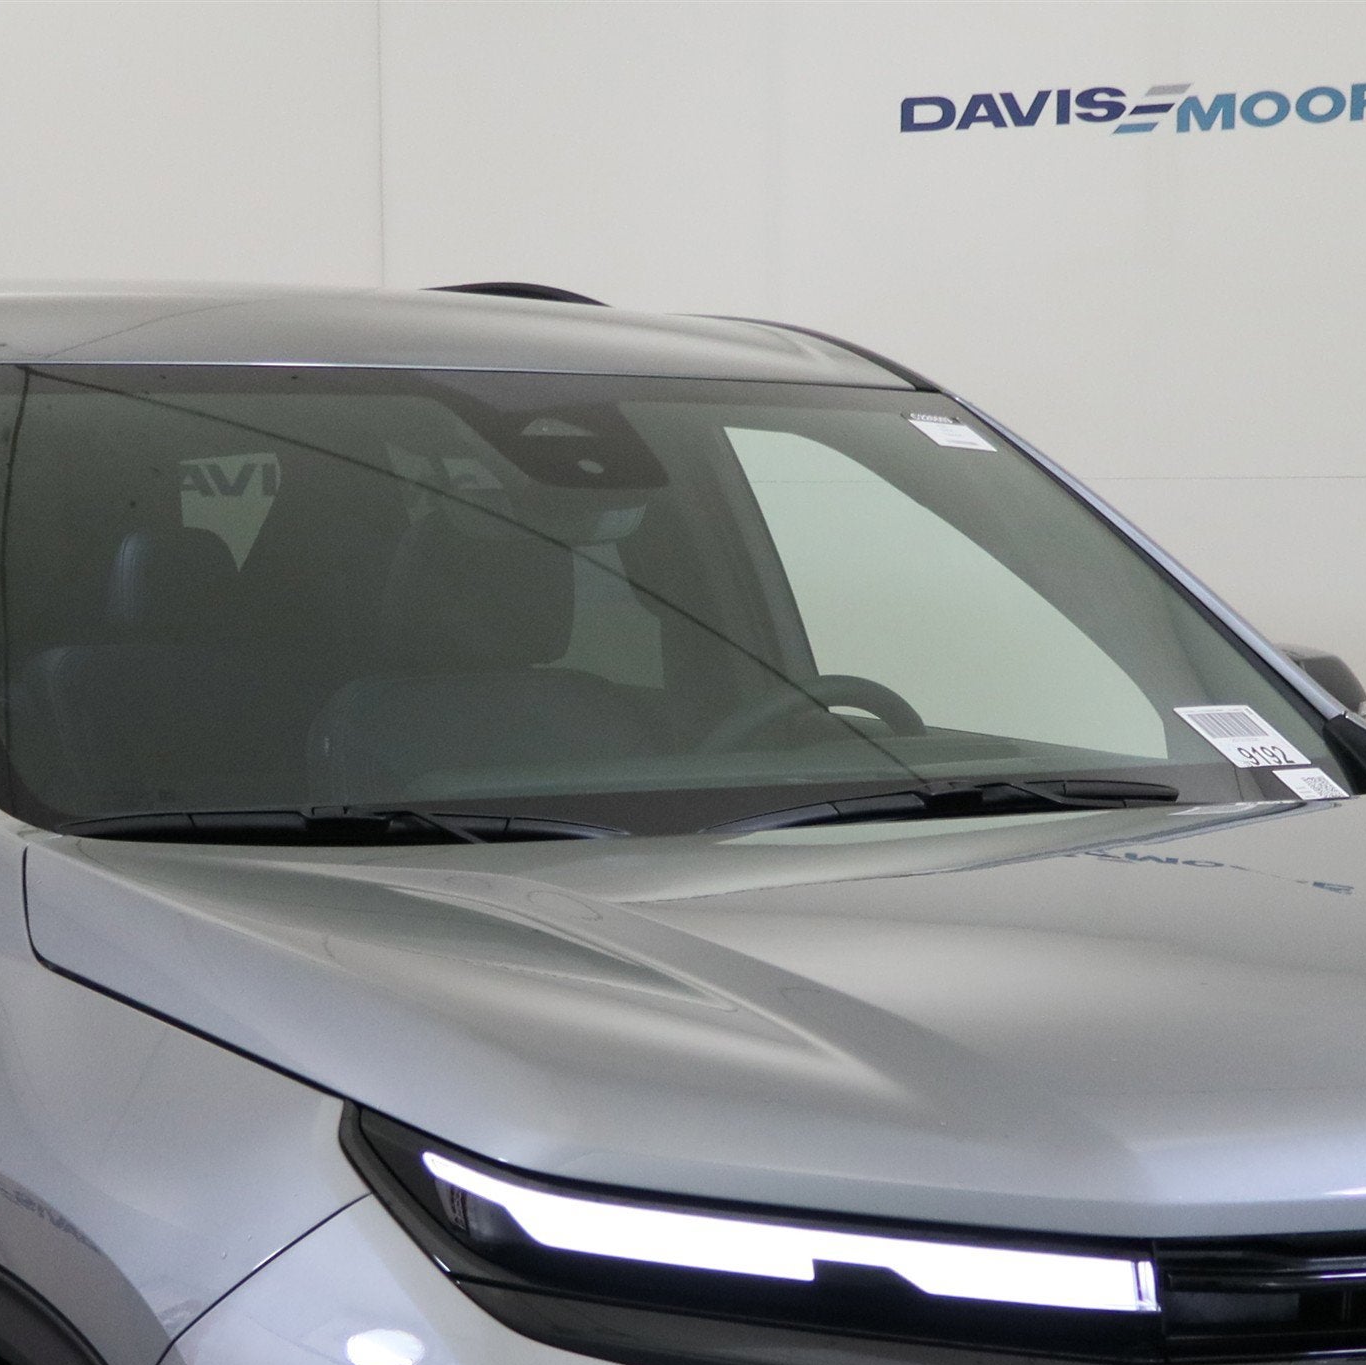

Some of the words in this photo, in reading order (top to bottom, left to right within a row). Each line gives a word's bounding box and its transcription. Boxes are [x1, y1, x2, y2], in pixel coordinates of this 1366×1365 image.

[900, 86, 1127, 133] DAVIS
[180, 463, 277, 497] AVI
[1237, 745, 1296, 766] 9192
